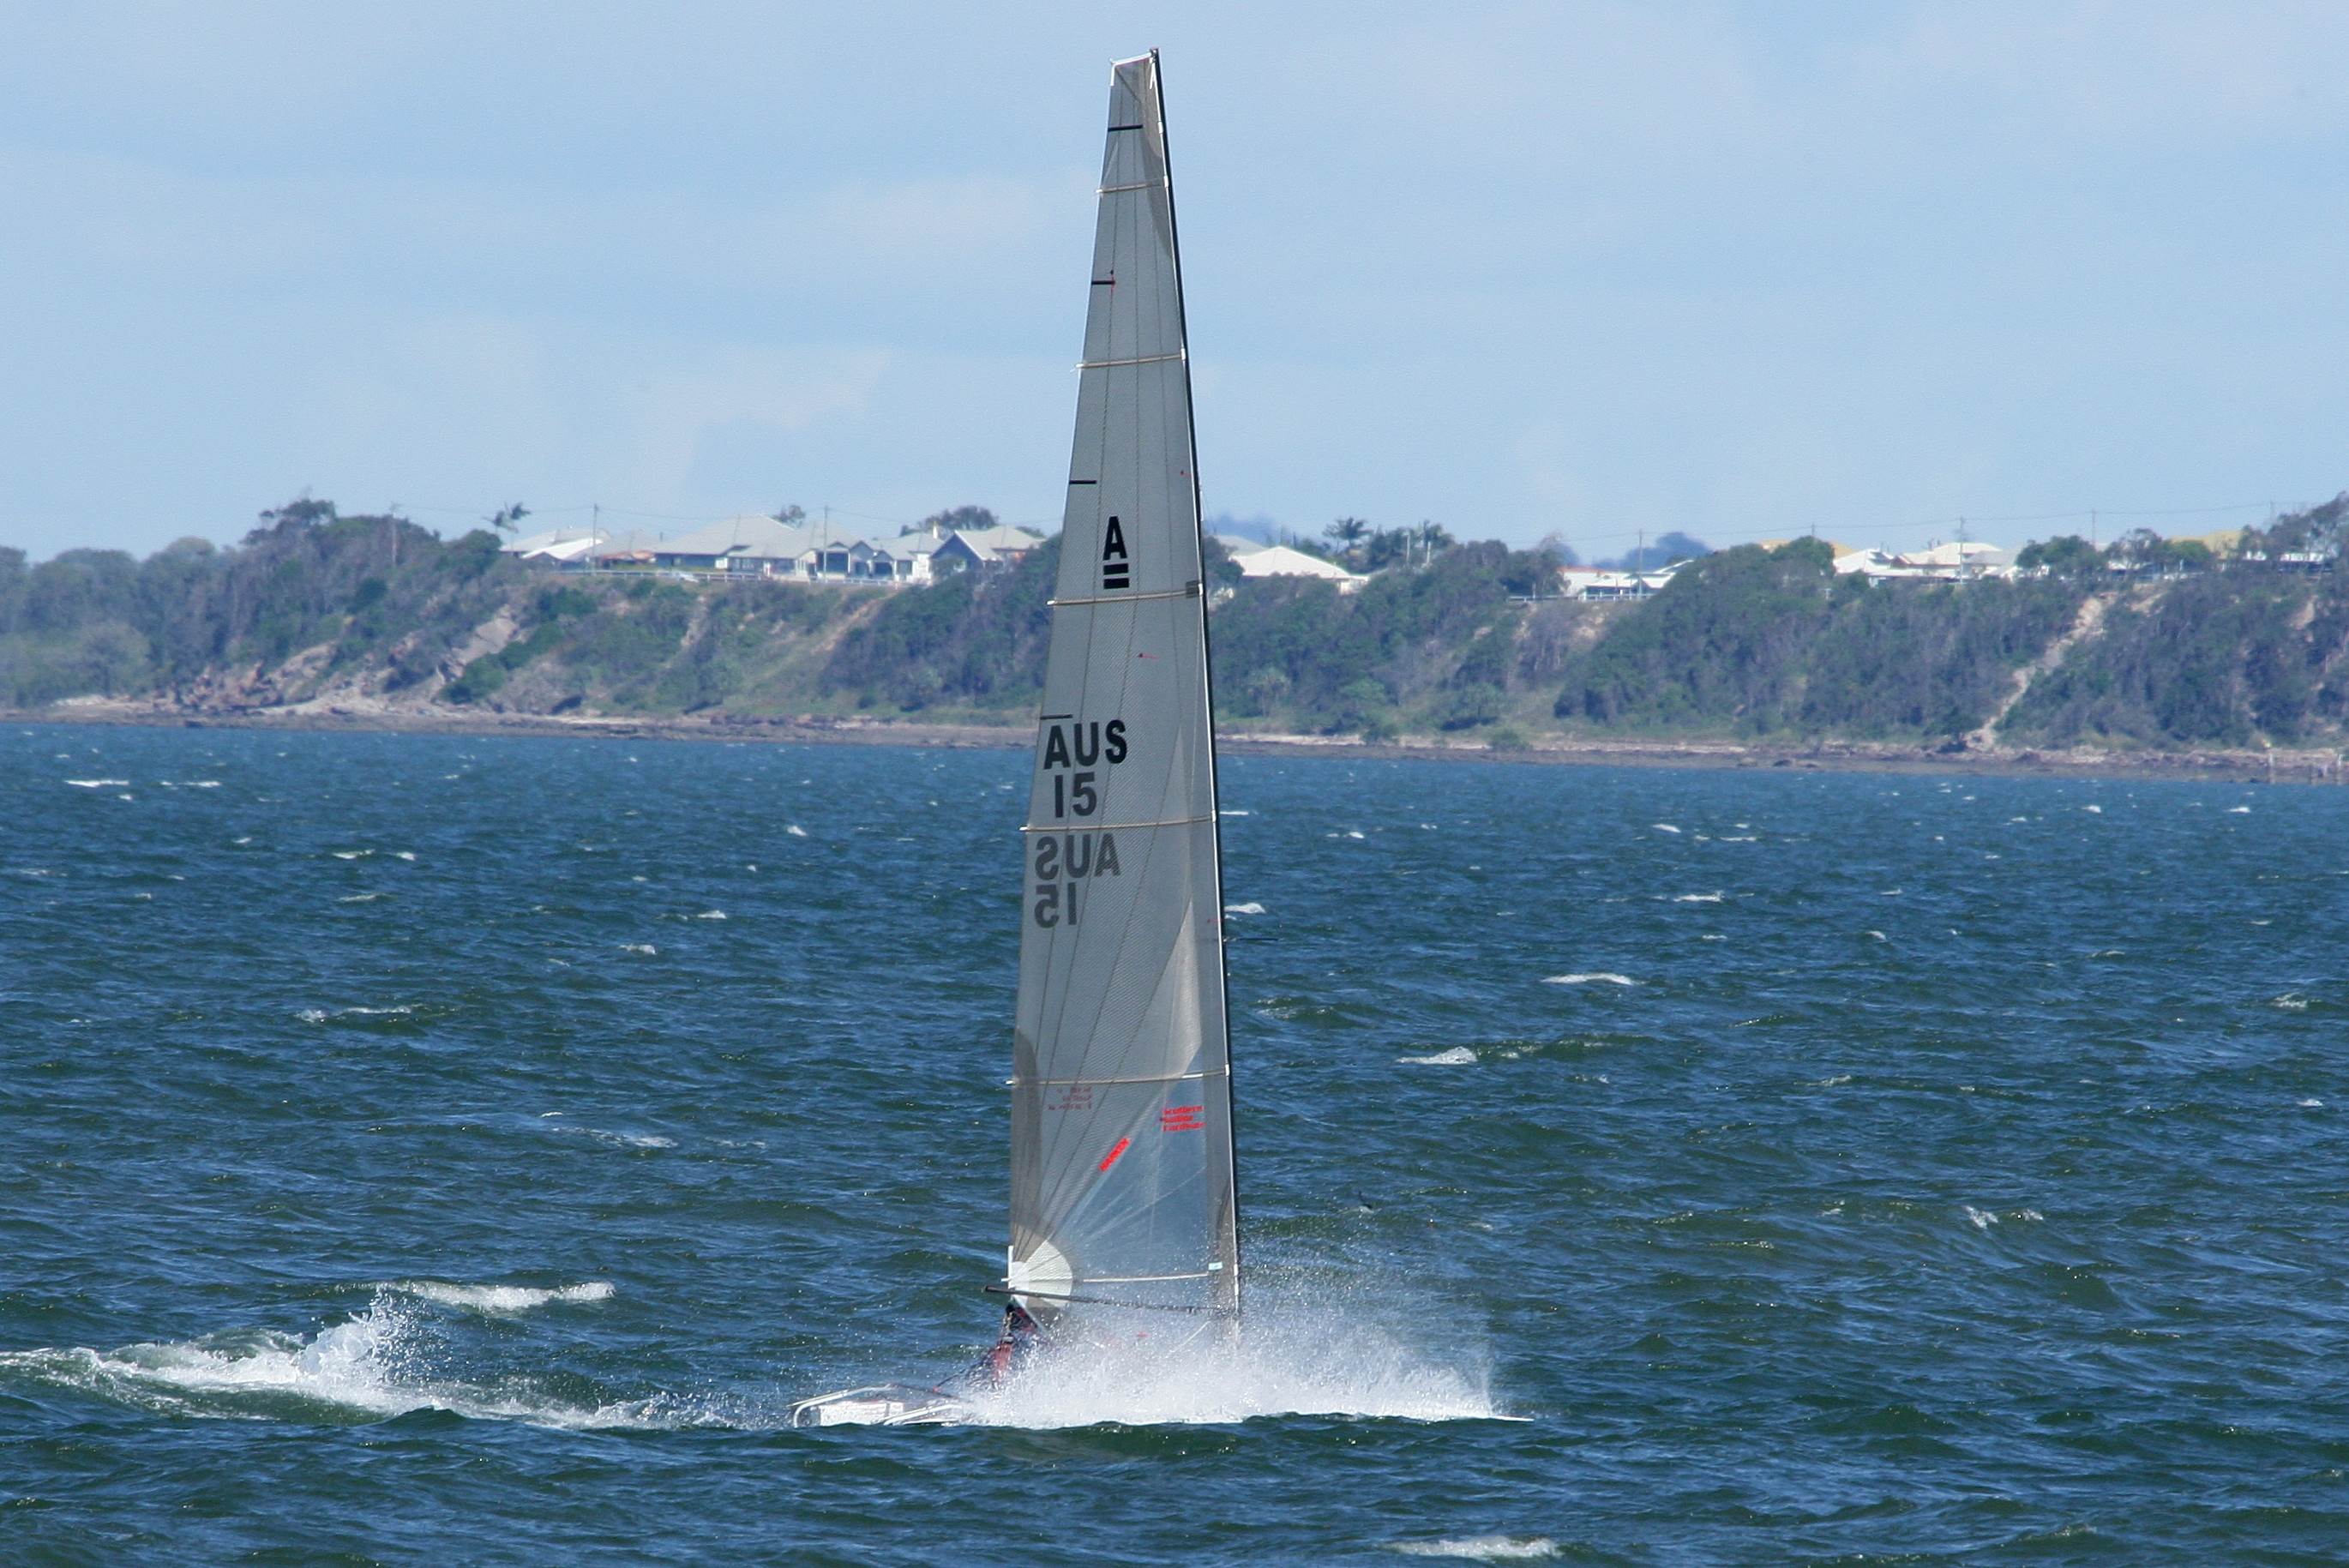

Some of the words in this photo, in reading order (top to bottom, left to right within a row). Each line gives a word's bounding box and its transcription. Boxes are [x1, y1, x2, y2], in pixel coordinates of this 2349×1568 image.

[1102, 515, 1128, 561] A
[1043, 719, 1127, 770] AUS
[1054, 772, 1097, 818] 15
